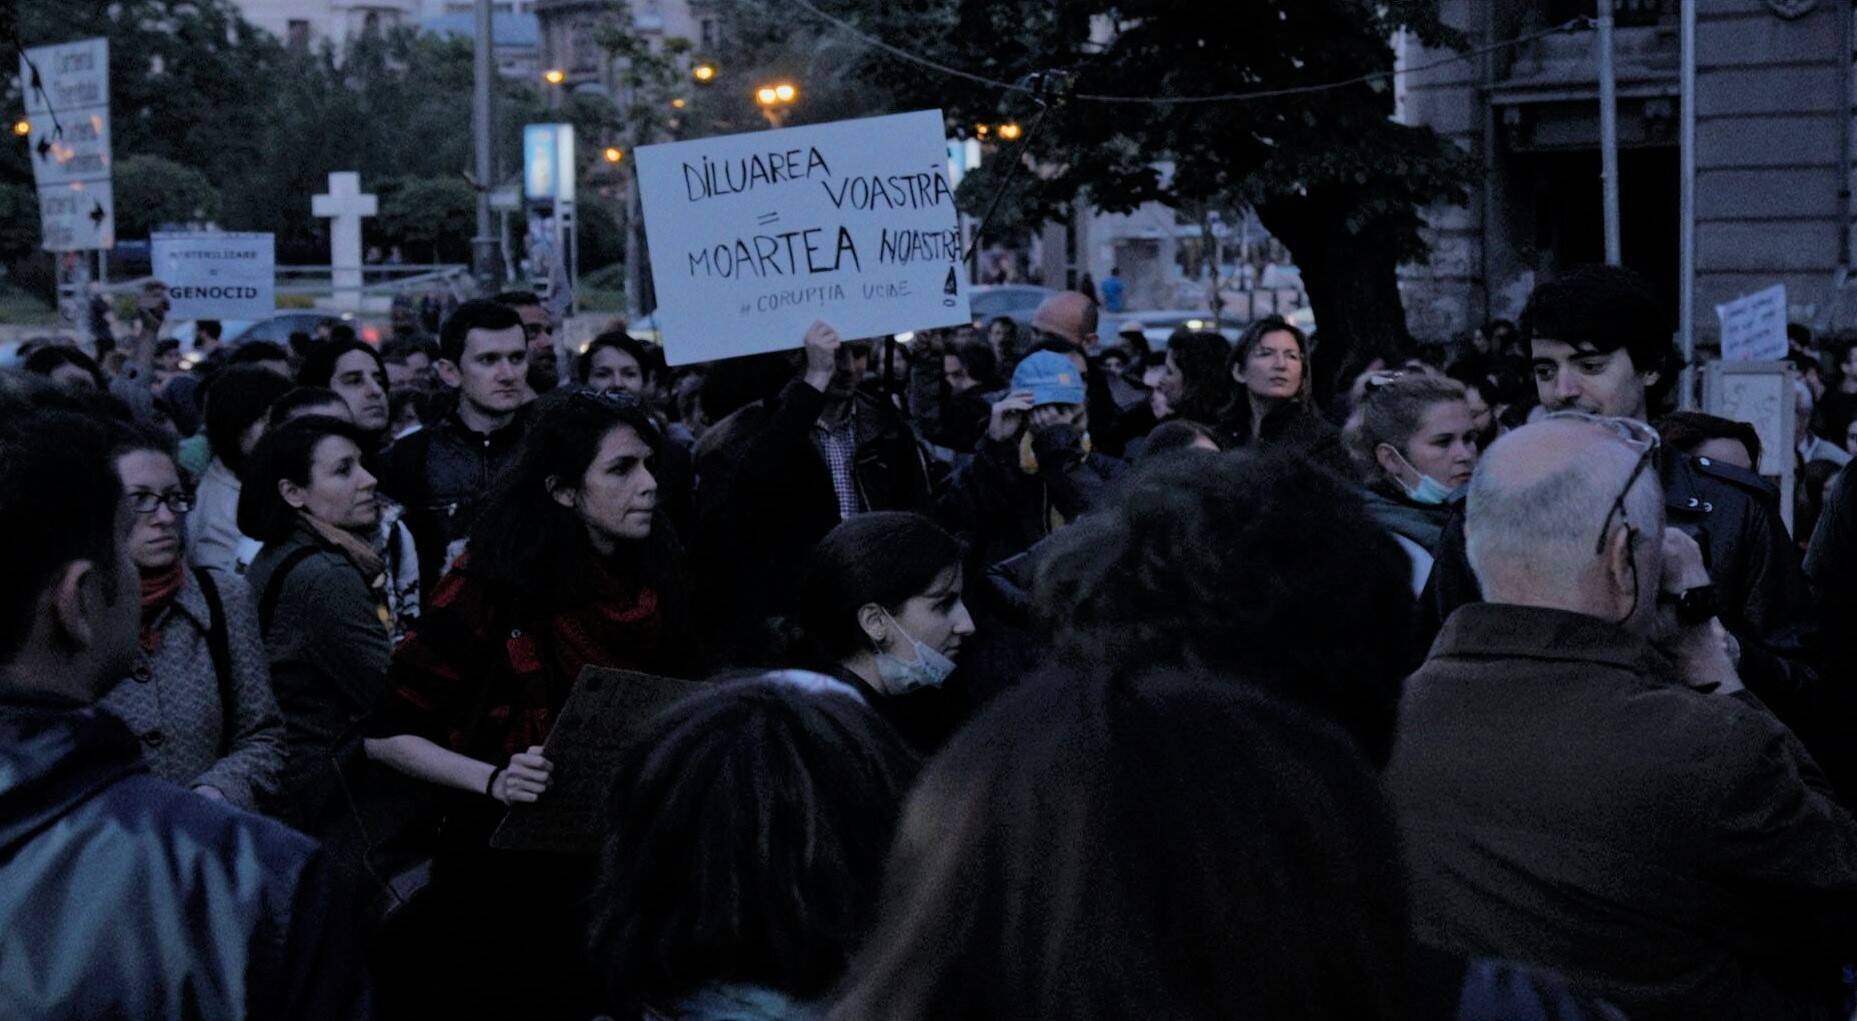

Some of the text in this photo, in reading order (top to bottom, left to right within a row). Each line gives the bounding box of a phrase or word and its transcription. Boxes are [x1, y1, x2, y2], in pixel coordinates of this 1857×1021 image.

[169, 250, 257, 260] NSTERILIZARE
[688, 226, 861, 280] MOARTEA
[169, 286, 258, 300] GENOCID
